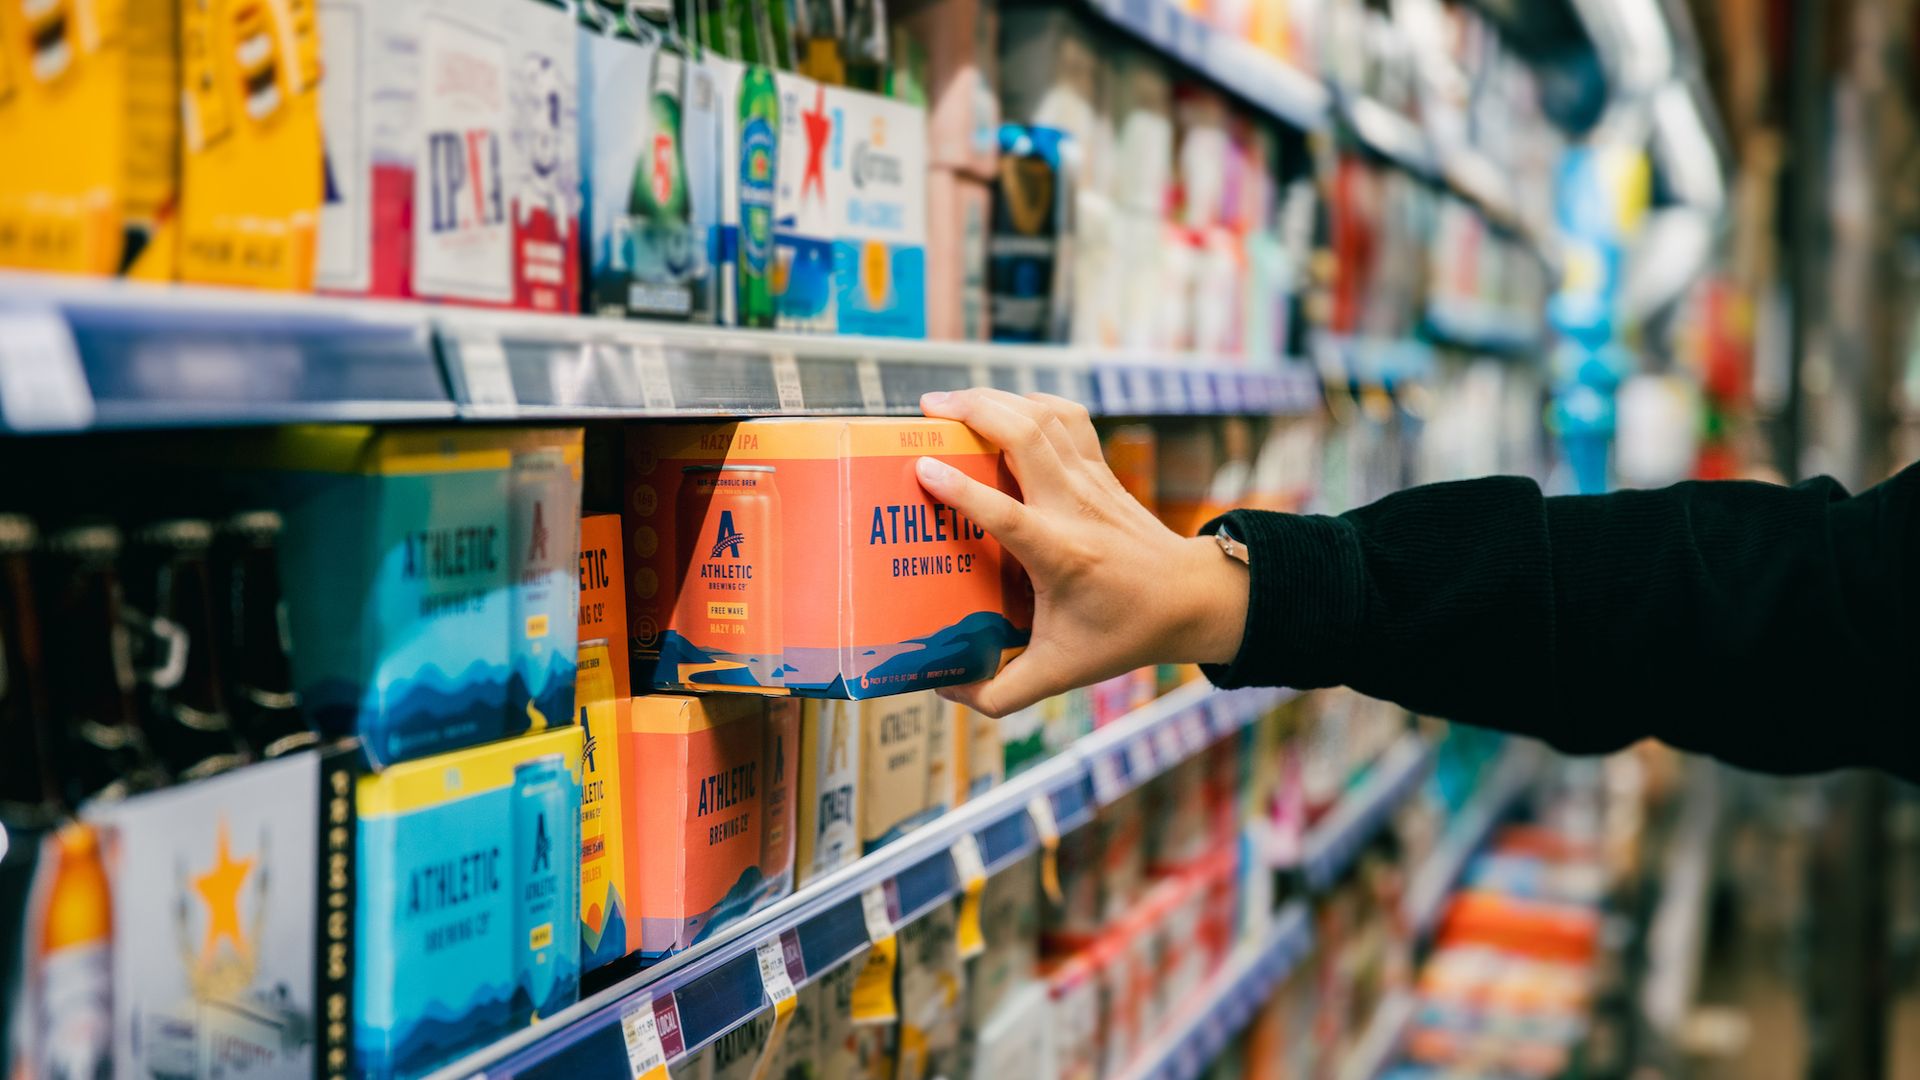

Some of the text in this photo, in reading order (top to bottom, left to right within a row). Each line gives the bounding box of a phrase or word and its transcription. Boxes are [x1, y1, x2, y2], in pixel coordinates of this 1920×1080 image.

[700, 433, 758, 450] HAZY IPA
[900, 431, 944, 447] HAZY IPA
[402, 525, 499, 581] ATHLETIC
[579, 548, 609, 591] ETIC
[701, 564, 753, 579] ATHLETIC
[893, 554, 952, 577] BREWING
[709, 582, 736, 590] BREWING
[711, 606, 743, 616] FREE WAVE
[710, 623, 746, 635] HAZY IPA
[861, 672, 869, 689] 6
[581, 780, 604, 806] LETIC
[698, 761, 756, 817] ATHLETIC
[710, 817, 739, 847] BREWING
[408, 844, 501, 917] ATHLETIC
[656, 1010, 678, 1037] LOCAL
[327, 992, 347, 1080] BEE
